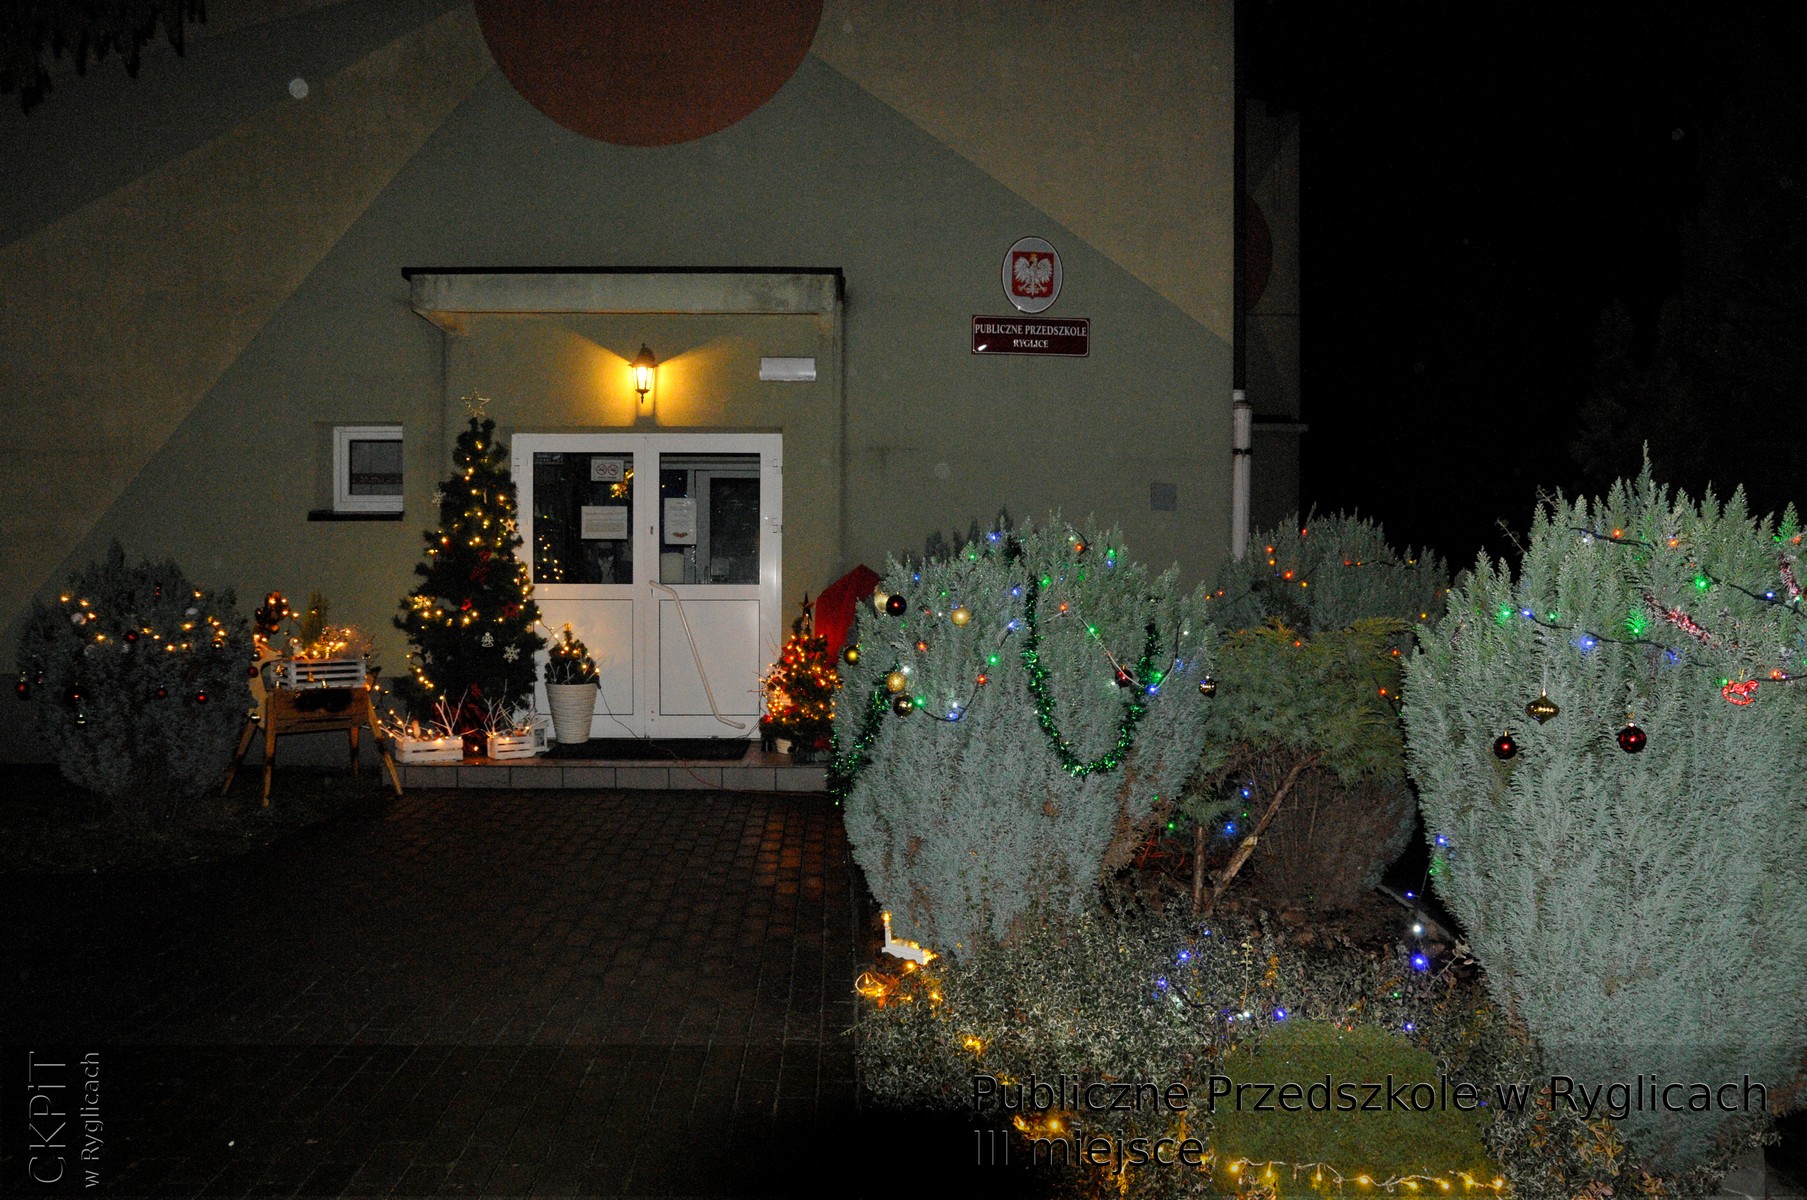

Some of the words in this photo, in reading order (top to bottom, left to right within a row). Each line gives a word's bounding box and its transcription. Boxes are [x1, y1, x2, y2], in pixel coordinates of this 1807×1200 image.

[975, 324, 1023, 335] PUBLICZNE
[1025, 325, 1087, 337] PRZEDSZKOLE
[1013, 339, 1049, 348] RYGLICE
